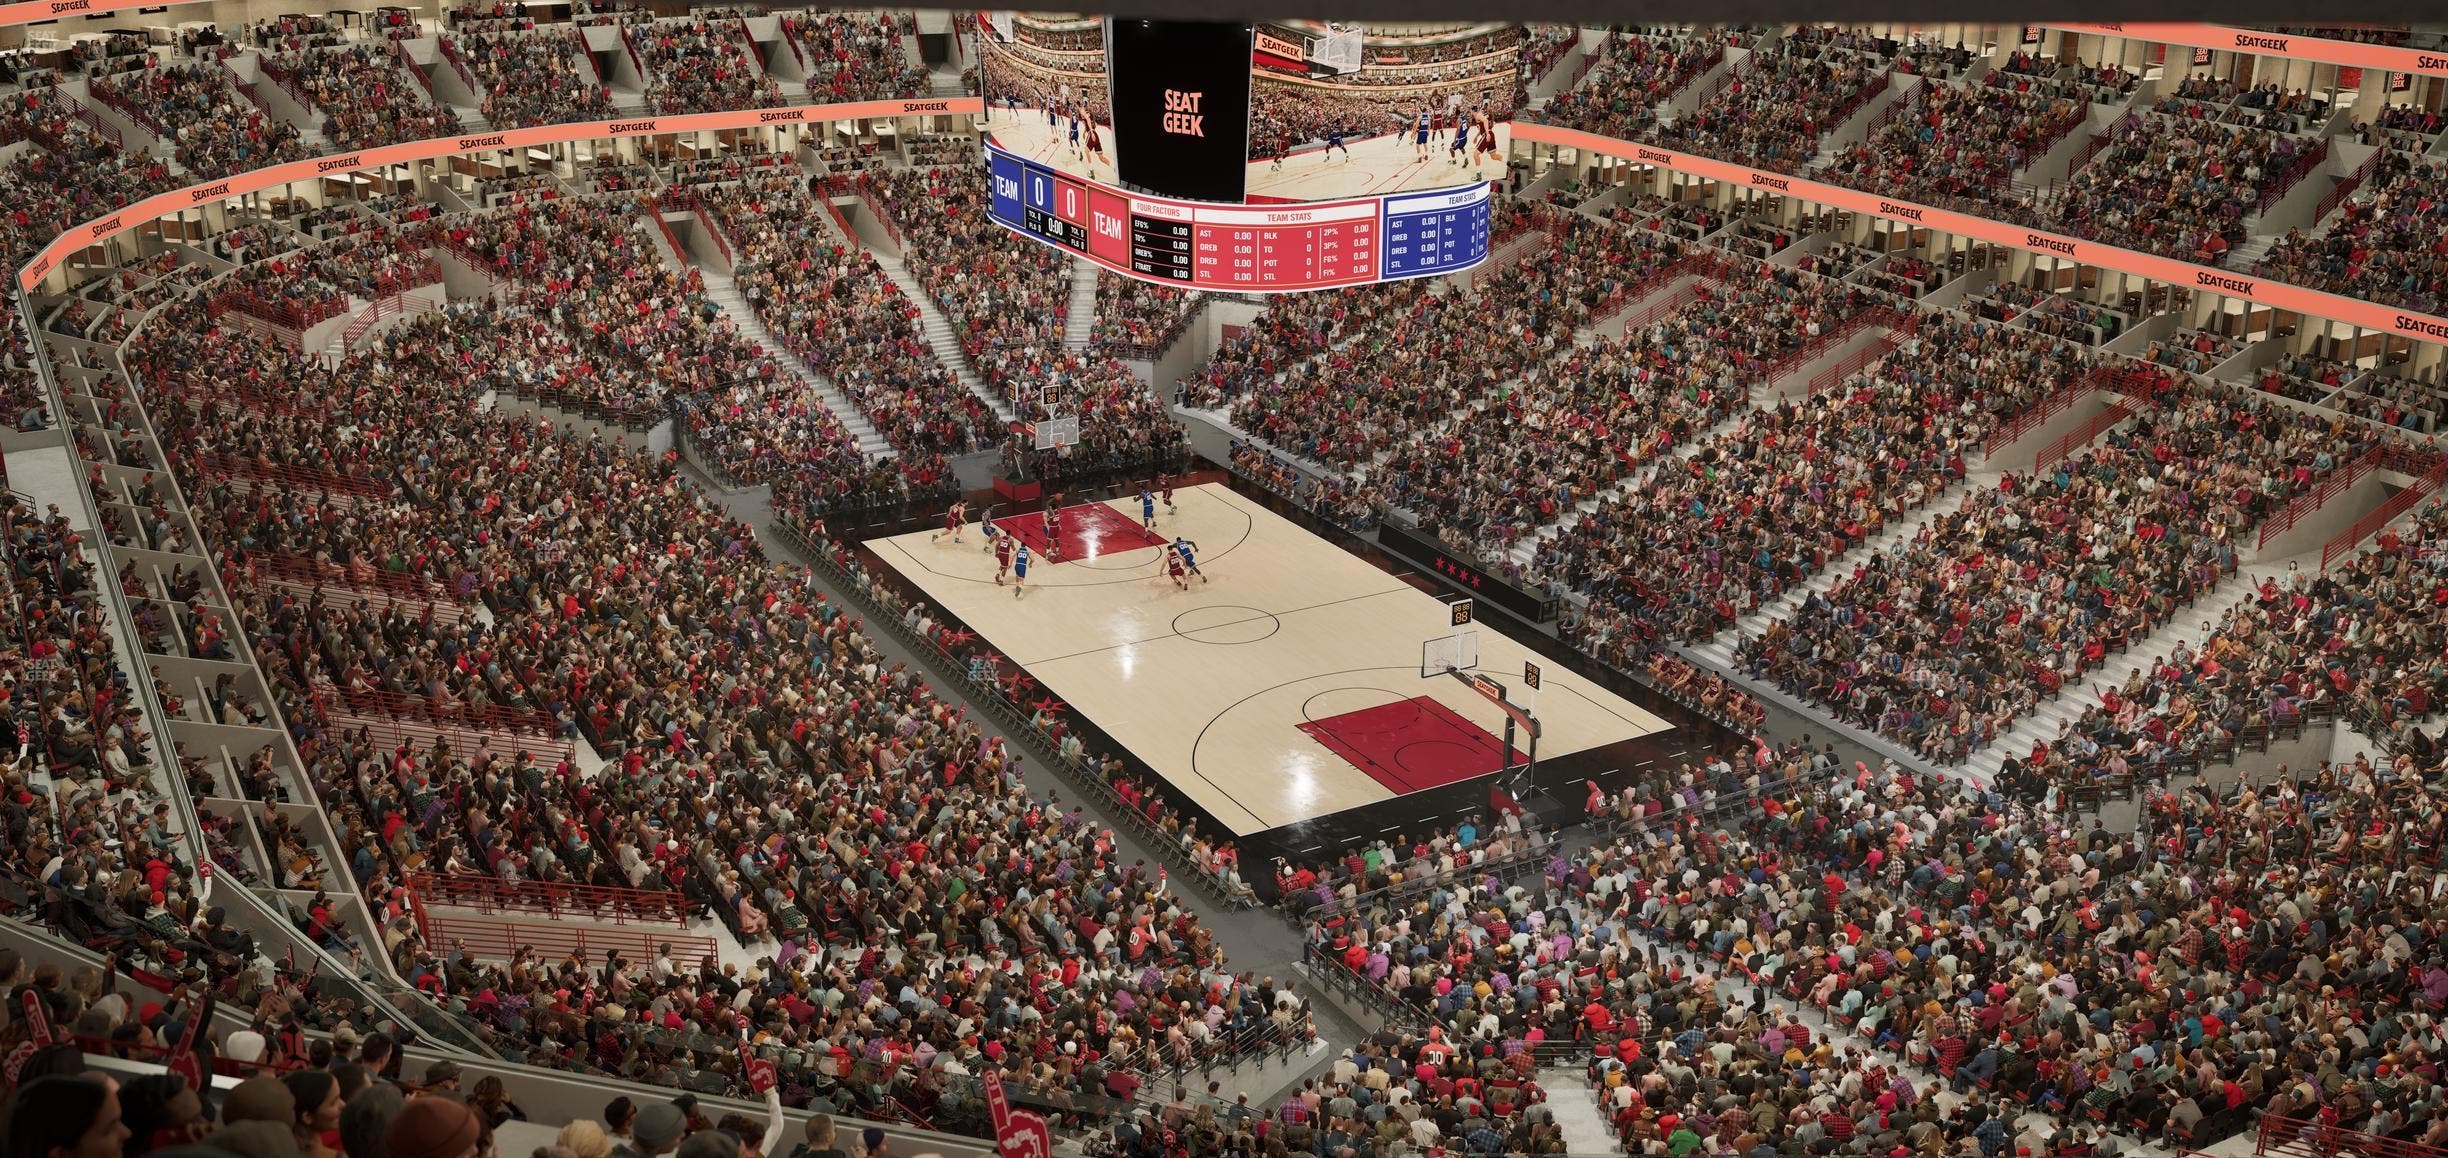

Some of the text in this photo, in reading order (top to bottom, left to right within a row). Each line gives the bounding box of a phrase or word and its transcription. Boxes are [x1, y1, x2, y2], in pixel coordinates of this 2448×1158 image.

[51, 0, 90, 14] SEATGEEK
[1261, 37, 1300, 58] SEATGEEK
[2235, 34, 2288, 52] SEATGEEK
[1164, 88, 1202, 113] SEAT
[904, 102, 948, 112] SEATGEEK
[760, 110, 804, 122] SEATGEEK
[609, 121, 656, 134] SEATGEEK
[1163, 112, 1205, 138] GEEK
[459, 136, 505, 150] SEATGEEK
[1638, 149, 1672, 166] SEATGEEK
[318, 155, 361, 173] SEATGEEK
[995, 174, 1018, 201] TEAM
[1751, 173, 1789, 191] SEATGEEK
[192, 183, 230, 202] SEATGEEK
[1034, 176, 1043, 206] 0
[1066, 188, 1076, 218] 0
[1448, 192, 1476, 205] TEAM STATS
[1137, 202, 1180, 217] FOUR FACTORS
[1880, 202, 1923, 221] SEATGEEK
[1267, 212, 1312, 222] TEAM STATS
[1392, 217, 1437, 229] AST 0.00
[1445, 214, 1456, 222] BLK
[92, 216, 122, 238] SEATGEEK
[1048, 217, 1063, 236] 0:00
[1093, 211, 1122, 241] TEAM
[1173, 226, 1188, 236] 0.00
[1354, 224, 1369, 233] 0.00
[1234, 231, 1251, 240] 0.00
[1264, 230, 1312, 240] BLK 0
[1391, 230, 1436, 242] OREB 0.00
[1173, 240, 1188, 250] 0.00
[1306, 244, 1312, 252] 0
[1354, 238, 1369, 247] 0.00
[2026, 234, 2077, 256] SEATGEEK
[1234, 245, 1251, 254] 0.00
[1391, 243, 1436, 255] DREB 0.00
[1173, 255, 1188, 265] 0.00
[1264, 257, 1312, 267] POT 0
[1353, 252, 1368, 260] 0.00
[1391, 256, 1435, 268] STL 0.00
[1444, 254, 1453, 262] STL
[32, 256, 49, 280] SEATGEEK
[1234, 259, 1251, 267] 0.00
[1173, 269, 1188, 279] 0.00
[1353, 265, 1368, 274] 0.00
[1234, 272, 1251, 281] 0.00
[1264, 271, 1311, 281] STL 0
[2197, 272, 2254, 296] SEATGEEK
[1455, 611, 1468, 623] 88
